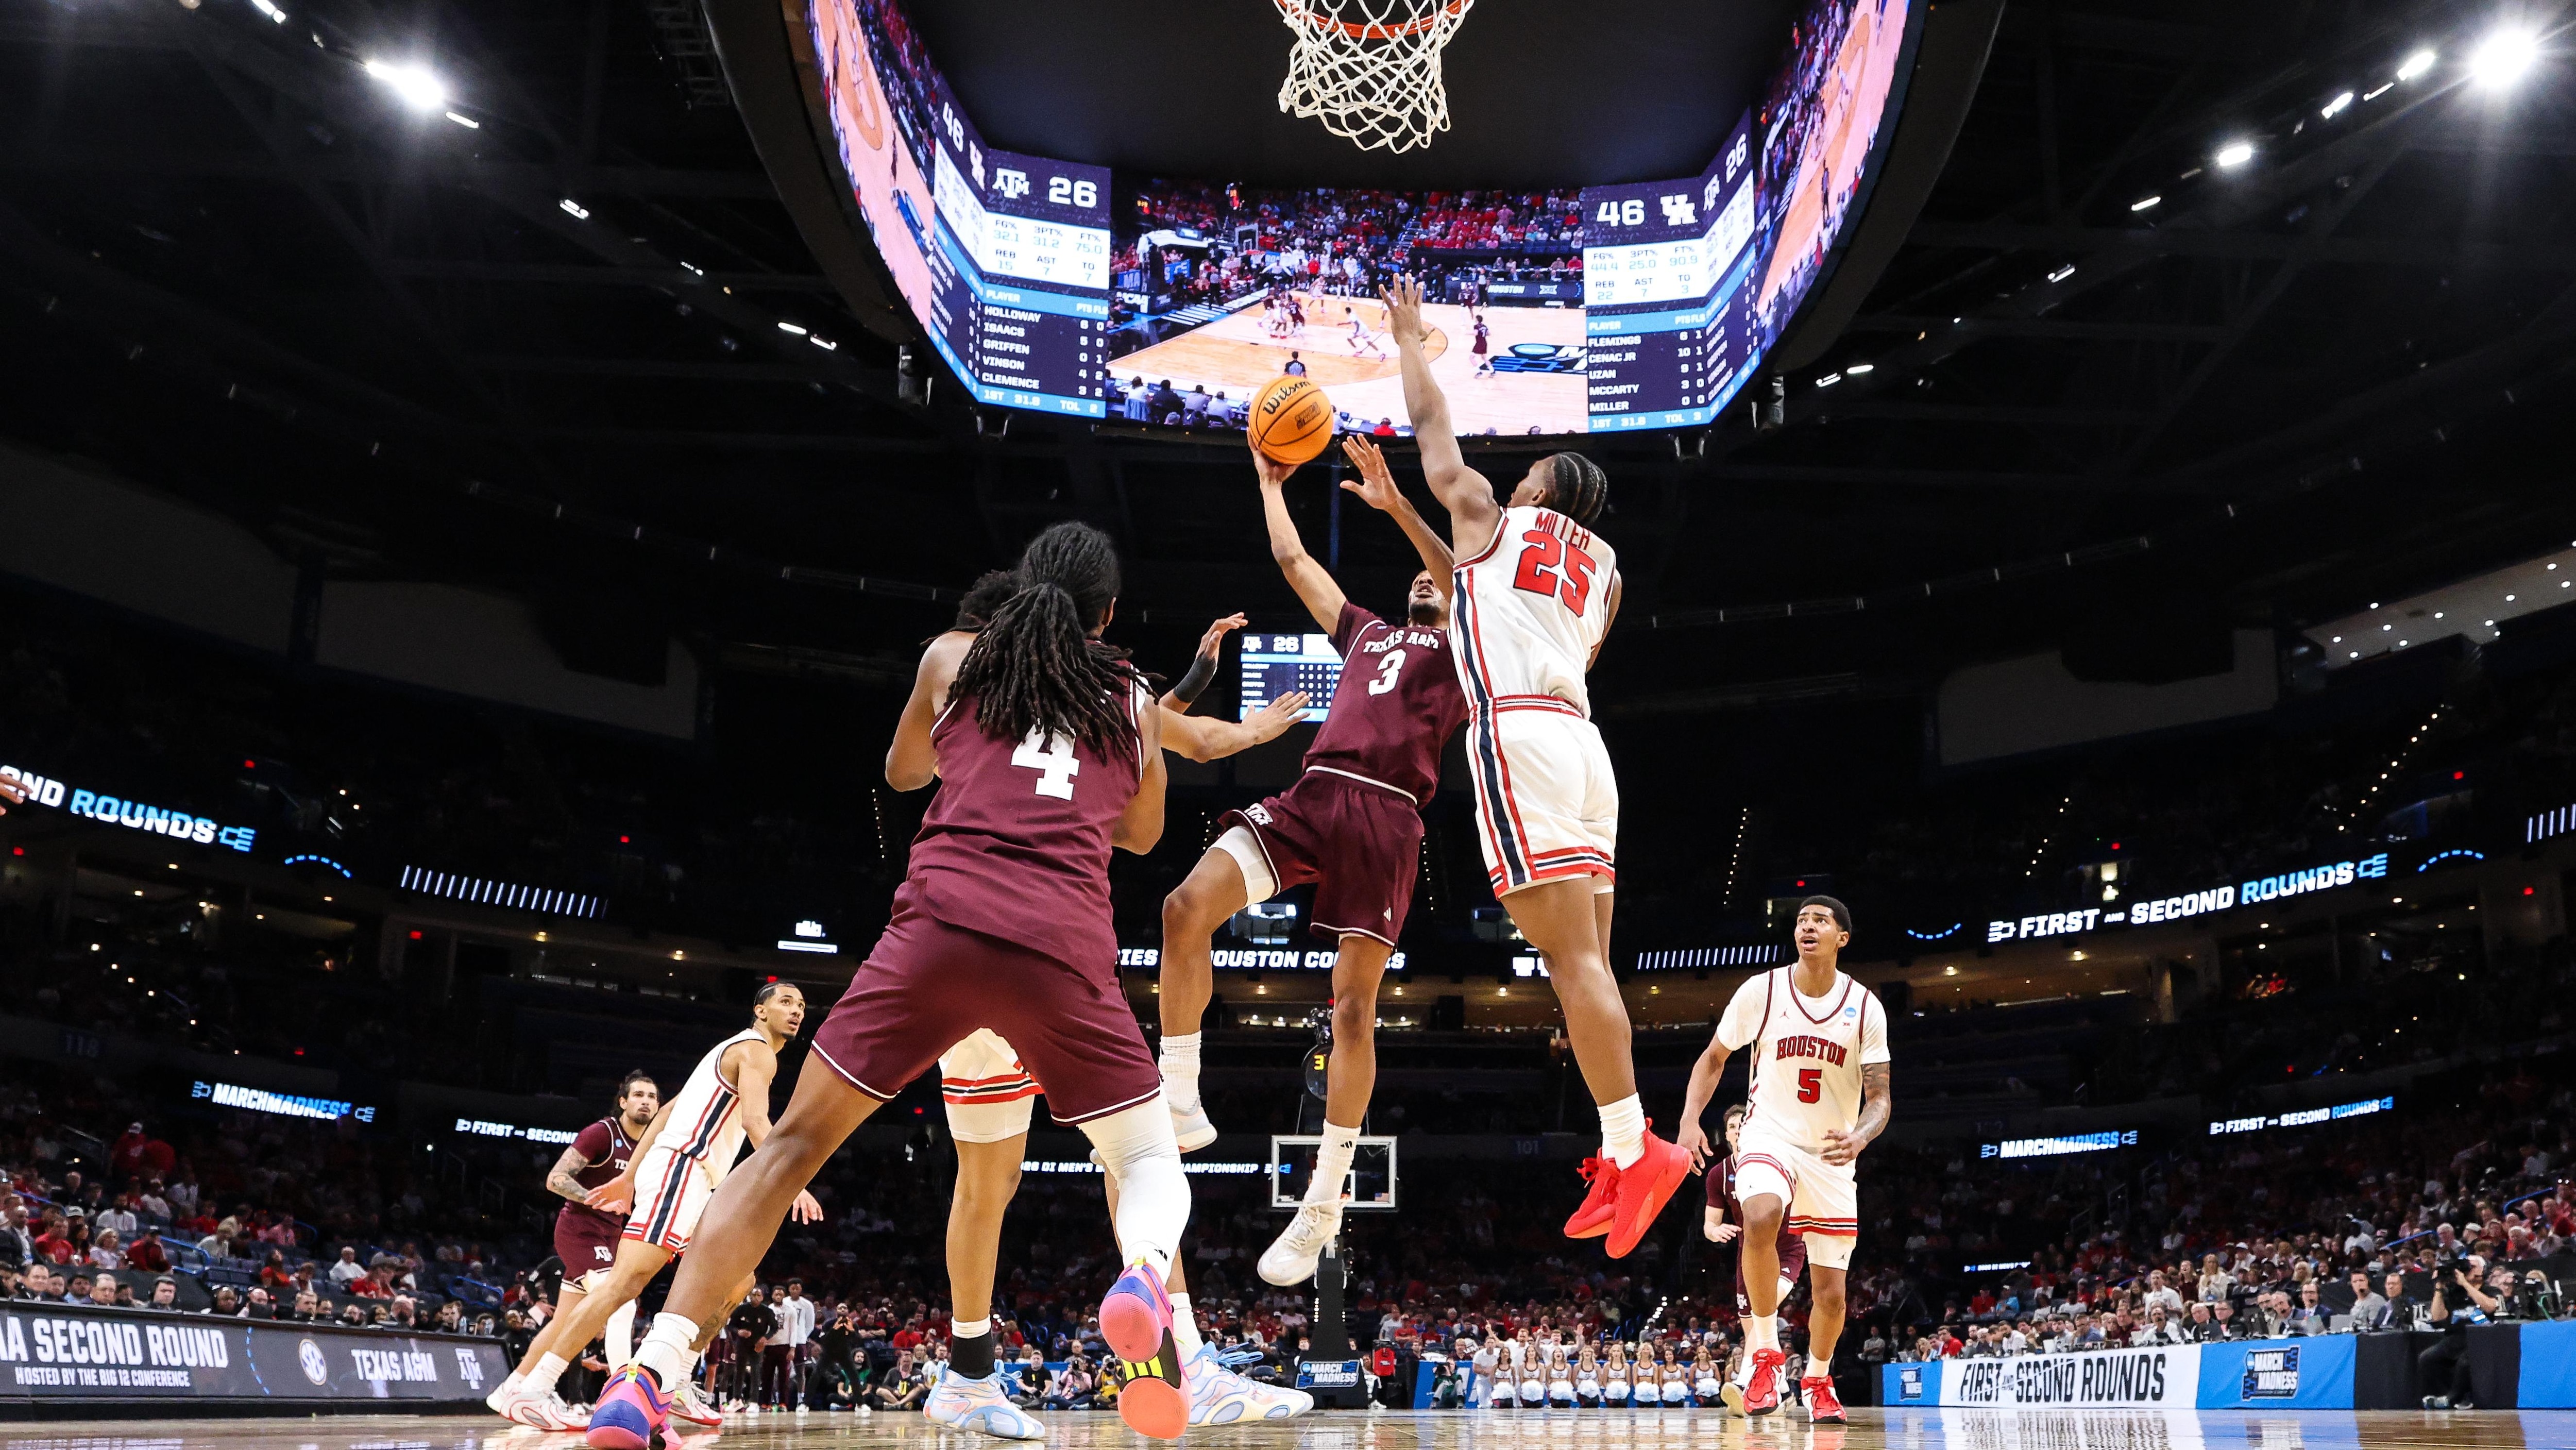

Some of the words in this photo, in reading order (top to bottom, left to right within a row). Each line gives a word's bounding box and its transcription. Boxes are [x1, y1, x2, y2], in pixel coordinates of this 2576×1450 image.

[943, 102, 964, 152] 46
[1726, 133, 1747, 183] 26
[1048, 176, 1097, 208] 26
[1597, 199, 1645, 227] 46
[994, 230, 1020, 242] 32.1
[1033, 237, 1059, 248] 31.2
[1075, 243, 1102, 255] 75.0
[995, 220, 1017, 230] FG%
[1035, 226, 1063, 237] 3PT%
[1080, 233, 1100, 242] FT%
[996, 249, 1015, 259] REB
[1037, 256, 1056, 264] AST
[1591, 262, 1618, 271] 44.4
[1629, 260, 1656, 269] 25.0
[1669, 255, 1698, 266] 90.9
[1631, 249, 1658, 258] 3PT%
[999, 260, 1012, 271] 15
[1043, 267, 1049, 276] 7
[1085, 274, 1091, 282] 7
[986, 290, 1020, 302] PLAYER
[1076, 303, 1093, 313] PTS
[1093, 305, 1109, 315] FLS
[1598, 292, 1613, 300] 22
[1681, 285, 1688, 293] 3
[985, 306, 1041, 323] HOLLOWAY
[1096, 322, 1104, 331] 0
[1588, 321, 1621, 330] PLAYER
[1675, 315, 1690, 325] PTS
[1691, 313, 1705, 323] FLS
[984, 322, 1025, 338] ISAACS
[1096, 338, 1104, 347] 0
[1588, 335, 1641, 347] FLEMINGS
[1696, 330, 1702, 339] 1
[983, 339, 1030, 355] GRIFFEN
[1079, 352, 1088, 362] 0
[1096, 355, 1103, 364] 1
[1588, 353, 1623, 363] CENAC
[1623, 352, 1636, 361] JR
[1677, 347, 1691, 357] 10
[1696, 346, 1703, 355] 1
[982, 356, 1025, 370] VINSON
[1078, 369, 1087, 379] 4
[1095, 371, 1103, 381] 2
[1588, 369, 1616, 379] UZAN
[1696, 362, 1703, 372] 1
[982, 373, 1040, 389] CLEMENCE
[1078, 386, 1087, 395] 3
[1095, 387, 1103, 397] 2
[1589, 384, 1639, 396] MCCARTY
[1681, 380, 1689, 389] 3
[1697, 378, 1704, 387] 0
[984, 390, 1004, 401] 1ST
[1060, 399, 1080, 411] TOL
[1090, 404, 1098, 413] 2
[1263, 381, 1311, 414] Wilson
[1589, 401, 1629, 412] MILLER
[1682, 396, 1690, 406] 0
[1697, 395, 1705, 403] 0
[1592, 418, 1612, 428] 1ST
[1665, 413, 1684, 423] TOL
[1693, 412, 1701, 420] 3
[1513, 530, 1596, 617] 25
[1273, 636, 1299, 652] 26
[1363, 630, 1404, 653] TEXAS
[1406, 631, 1439, 649] A&M
[1368, 649, 1406, 697] 3
[1011, 720, 1080, 801] 4
[70, 788, 217, 844] ROUNDS
[2020, 908, 2100, 938] FIRST
[2104, 912, 2125, 922] AND
[2131, 886, 2235, 924] SECOND
[2242, 861, 2354, 904] ROUNDS
[1776, 1035, 1848, 1068] HOUSTON
[1798, 1068, 1822, 1104] 5
[2226, 1117, 2266, 1133] FIRST
[2280, 1107, 2330, 1126] SECOND
[2332, 1099, 2380, 1119] ROUNDS
[472, 1121, 514, 1137] FIRST
[1058, 1162, 1093, 1173] MEN'S
[32, 1318, 143, 1365] SECOND
[146, 1325, 228, 1368] ROUND
[351, 1349, 401, 1381] TEXAS
[402, 1352, 437, 1382] A&M
[1310, 1363, 1343, 1373] MARCH
[2254, 1352, 2284, 1371] MARCH
[15, 1367, 60, 1385] HOSTED
[61, 1368, 75, 1385] BY
[77, 1369, 99, 1386] THE
[100, 1369, 117, 1386] BIG
[118, 1370, 130, 1386] 12
[131, 1370, 191, 1387] CONFERENCE
[1314, 1373, 1357, 1382] MADNESS
[1960, 1363, 2003, 1401] FIRST
[2016, 1358, 2076, 1402] SECOND
[2080, 1354, 2166, 1401] ROUNDS
[2258, 1371, 2298, 1390] MADNESS
